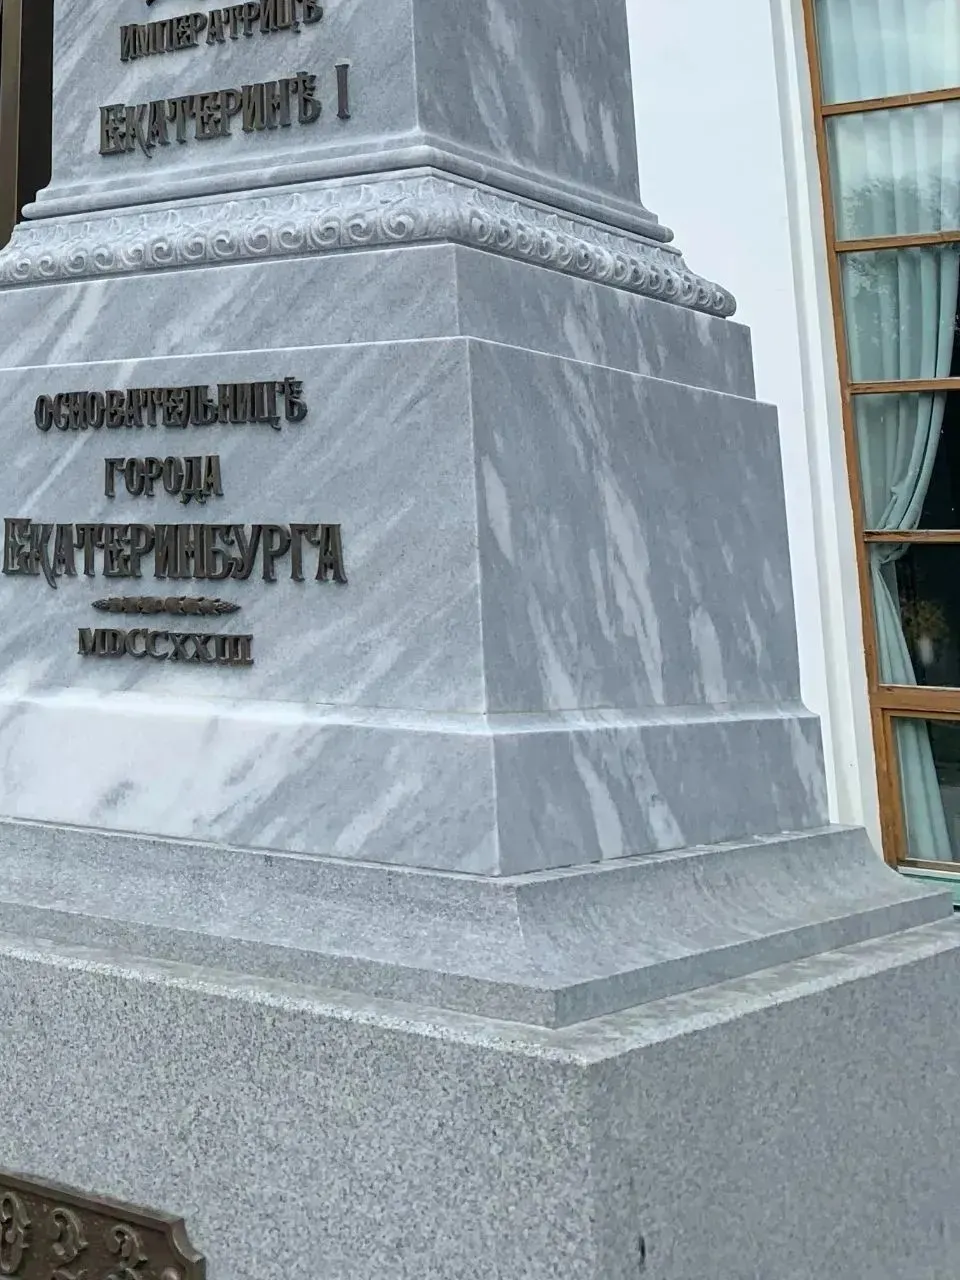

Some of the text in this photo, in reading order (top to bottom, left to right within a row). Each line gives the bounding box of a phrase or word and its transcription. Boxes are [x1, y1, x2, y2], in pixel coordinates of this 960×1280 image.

[99, 71, 323, 159] ЕКАТЕРИНѢ
[34, 377, 308, 431] ОСНОВАТЕЛЬНИЦѢ
[104, 455, 224, 504] ГОРОДА
[2, 518, 348, 589] ЕКАТЕРИНБУРГА
[78, 628, 254, 665] MDCCXXIII
